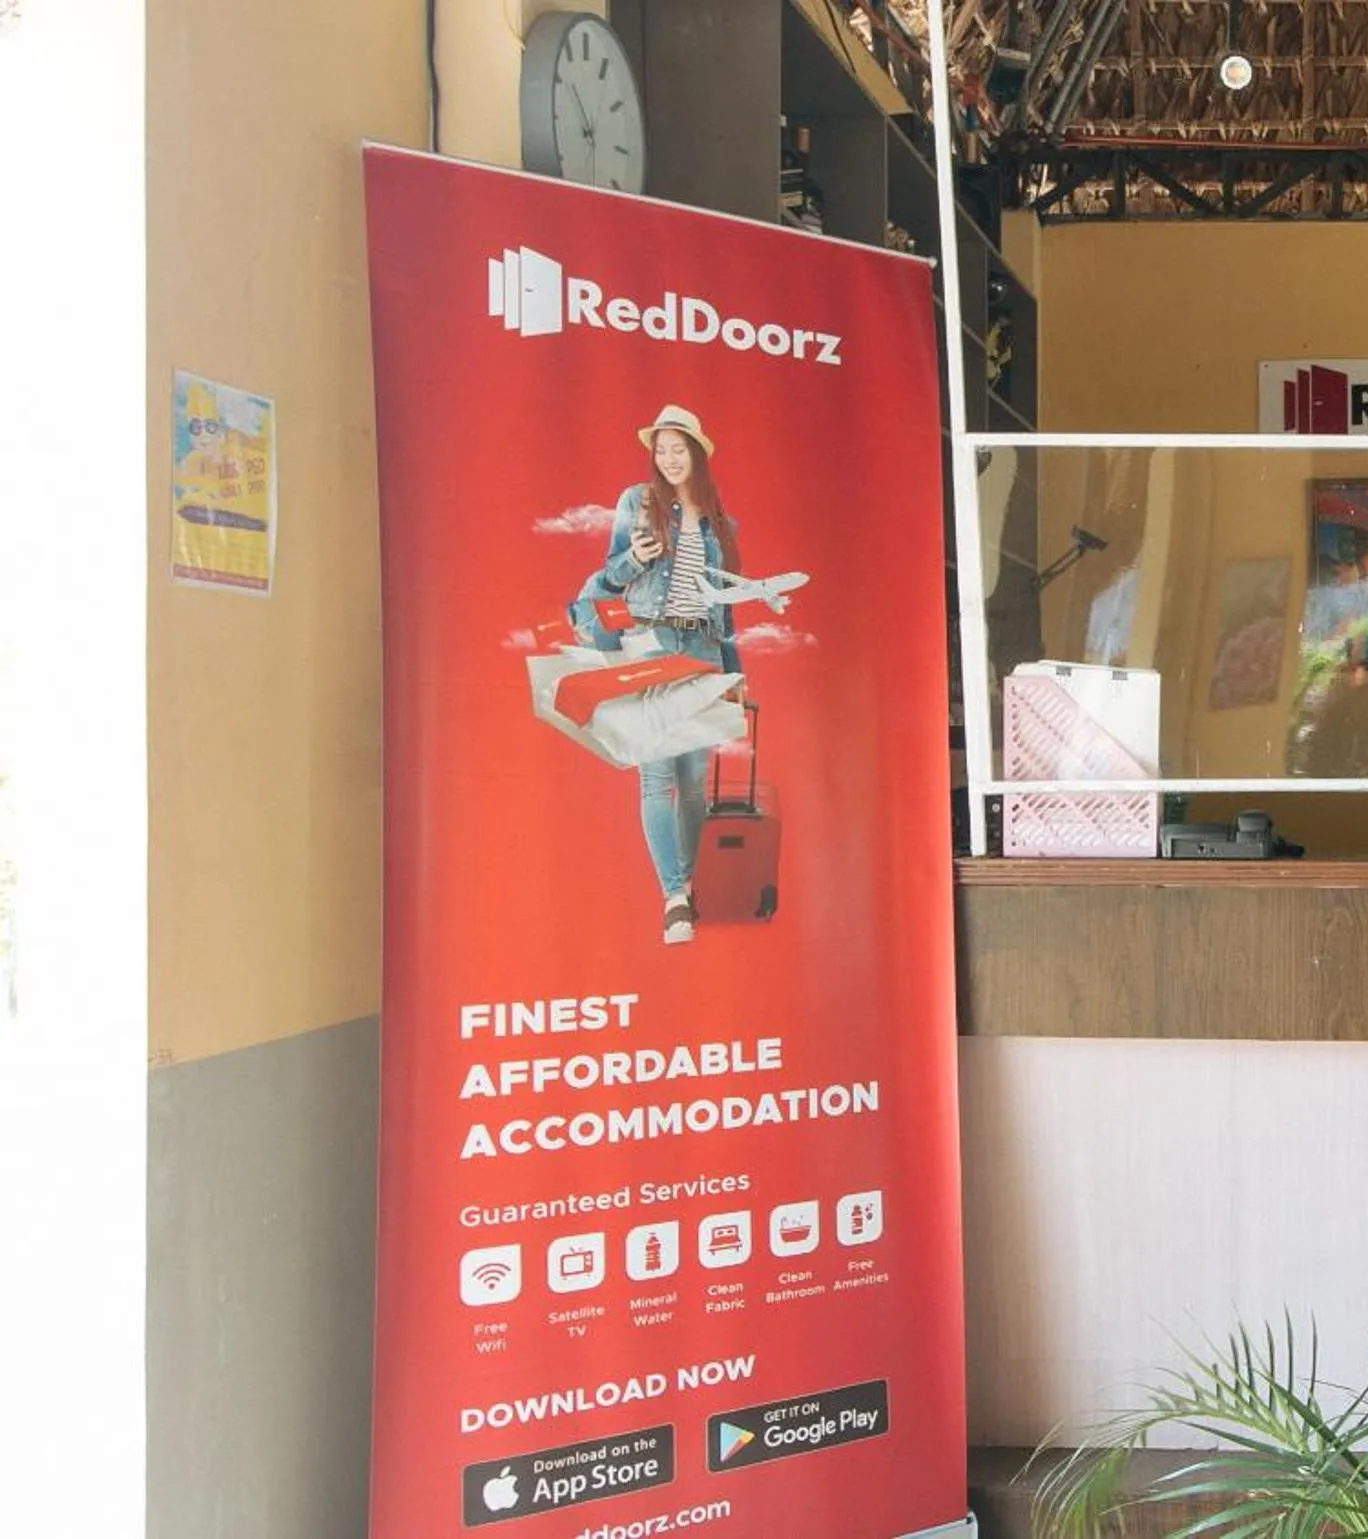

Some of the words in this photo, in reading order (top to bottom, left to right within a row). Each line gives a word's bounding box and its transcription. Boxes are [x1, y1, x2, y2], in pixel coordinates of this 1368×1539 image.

[567, 276, 842, 365] RedDoorz
[460, 994, 639, 1039] FINEST
[459, 1037, 782, 1100] AFFORDABLE
[460, 1081, 879, 1160] ACCOMMODATION
[459, 1186, 631, 1228] Guaranteed
[639, 1174, 750, 1204] Services
[847, 1260, 875, 1272] Free
[777, 1271, 813, 1285] Clean
[833, 1272, 889, 1291] Amenities
[706, 1282, 744, 1296] Clean
[765, 1285, 826, 1304] Bathroom
[629, 1291, 678, 1311] Mineral
[705, 1299, 745, 1314] Fabric
[548, 1306, 605, 1325] Satellite
[633, 1311, 673, 1327] Water
[473, 1322, 508, 1336] Free
[567, 1324, 587, 1338] TV
[460, 1373, 667, 1433] DOWNLOAD
[677, 1354, 755, 1391] NOW
[763, 1408, 787, 1424] GET
[789, 1405, 800, 1418] IT
[801, 1401, 820, 1416] ON
[763, 1415, 837, 1448] Google
[839, 1408, 879, 1432] Play
[533, 1445, 607, 1474] Download
[611, 1444, 630, 1457] on
[633, 1438, 657, 1453] the
[532, 1474, 587, 1504] App
[591, 1459, 659, 1489] Store
